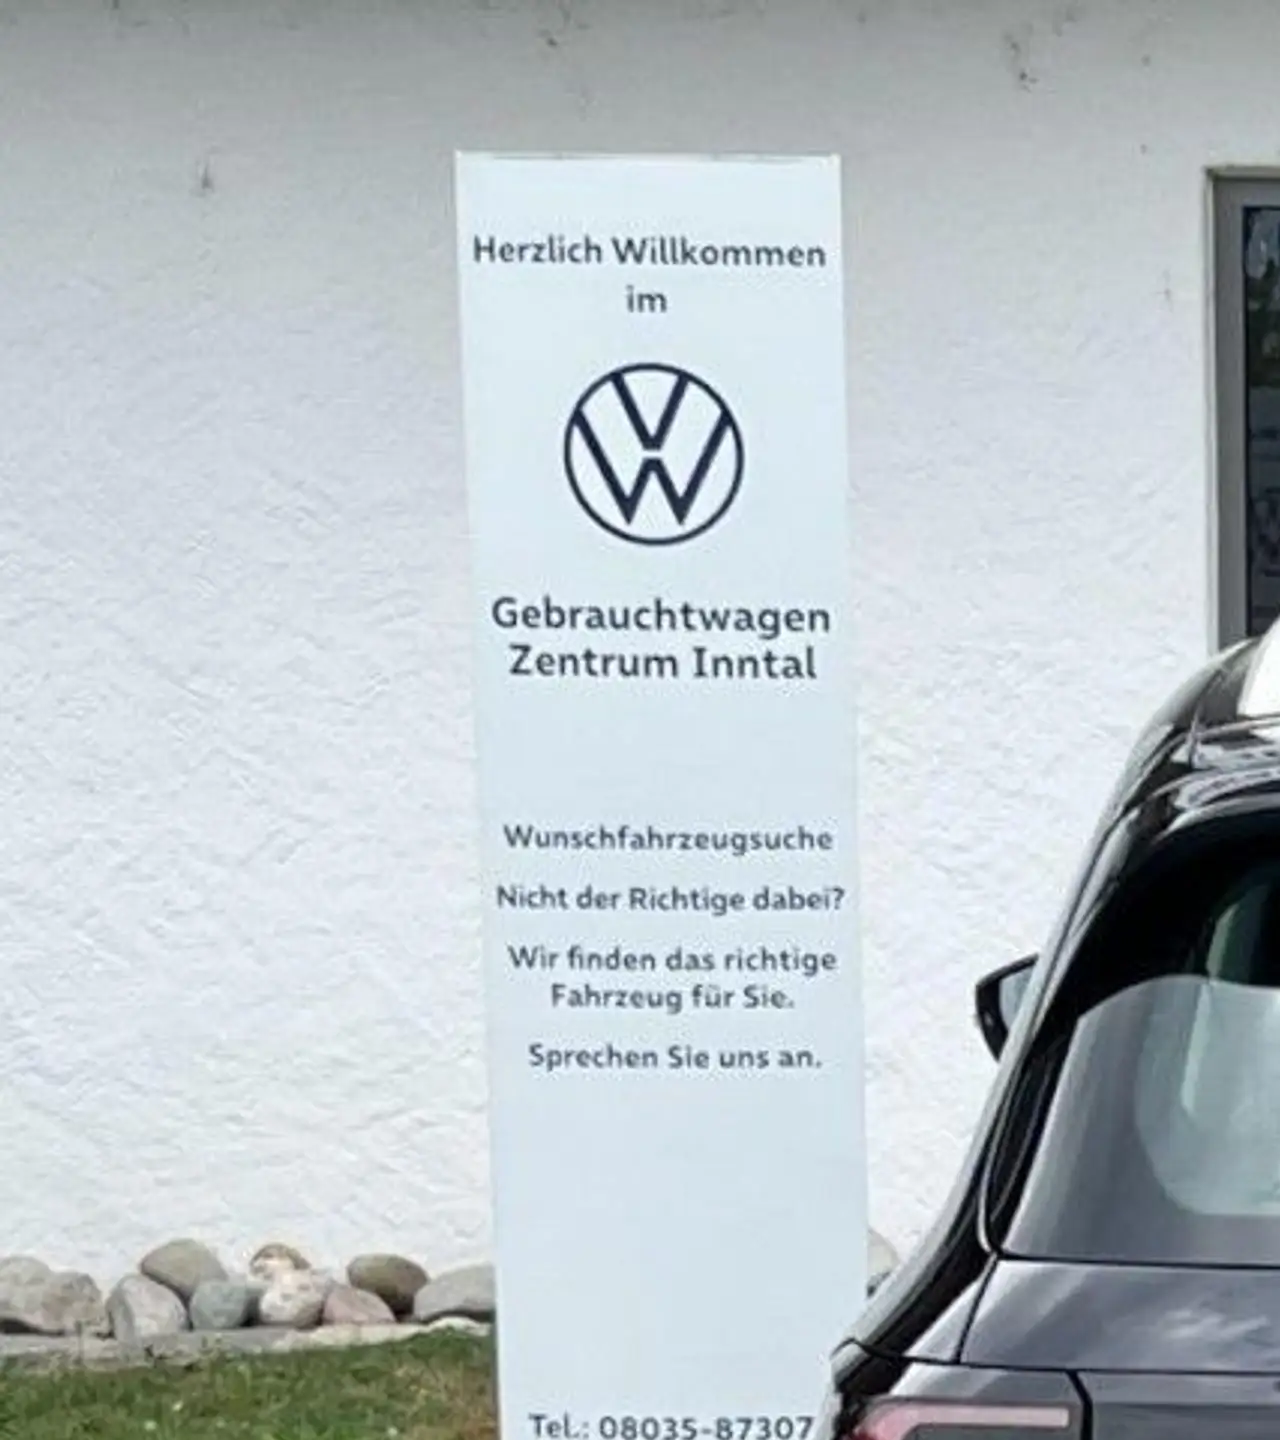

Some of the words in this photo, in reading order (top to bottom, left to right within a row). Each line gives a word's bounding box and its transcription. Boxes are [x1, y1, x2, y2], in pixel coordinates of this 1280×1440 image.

[472, 234, 602, 265] Herzlich
[612, 235, 827, 268] Willkommen
[627, 286, 667, 314] im
[491, 594, 832, 641] Gebrauchtwagen
[508, 644, 680, 679] Zentrum
[693, 645, 817, 681] Inntal
[502, 825, 834, 857] Wunschfahrzeugsuche
[496, 884, 568, 910] Nicht
[576, 885, 620, 911] der
[629, 886, 745, 916] Richtige
[752, 886, 846, 911] dabei?
[507, 945, 558, 970] Wir
[567, 944, 656, 971] finden
[665, 946, 715, 971] das
[724, 946, 838, 977] richtige
[550, 983, 683, 1015] Fahrzeug
[691, 984, 735, 1008] für
[742, 984, 796, 1009] Sie.
[528, 1042, 659, 1072] Sprechen
[668, 1044, 710, 1069] Sie
[718, 1049, 770, 1070] uns
[777, 1048, 823, 1069] an.
[528, 1412, 591, 1440] Tel.:
